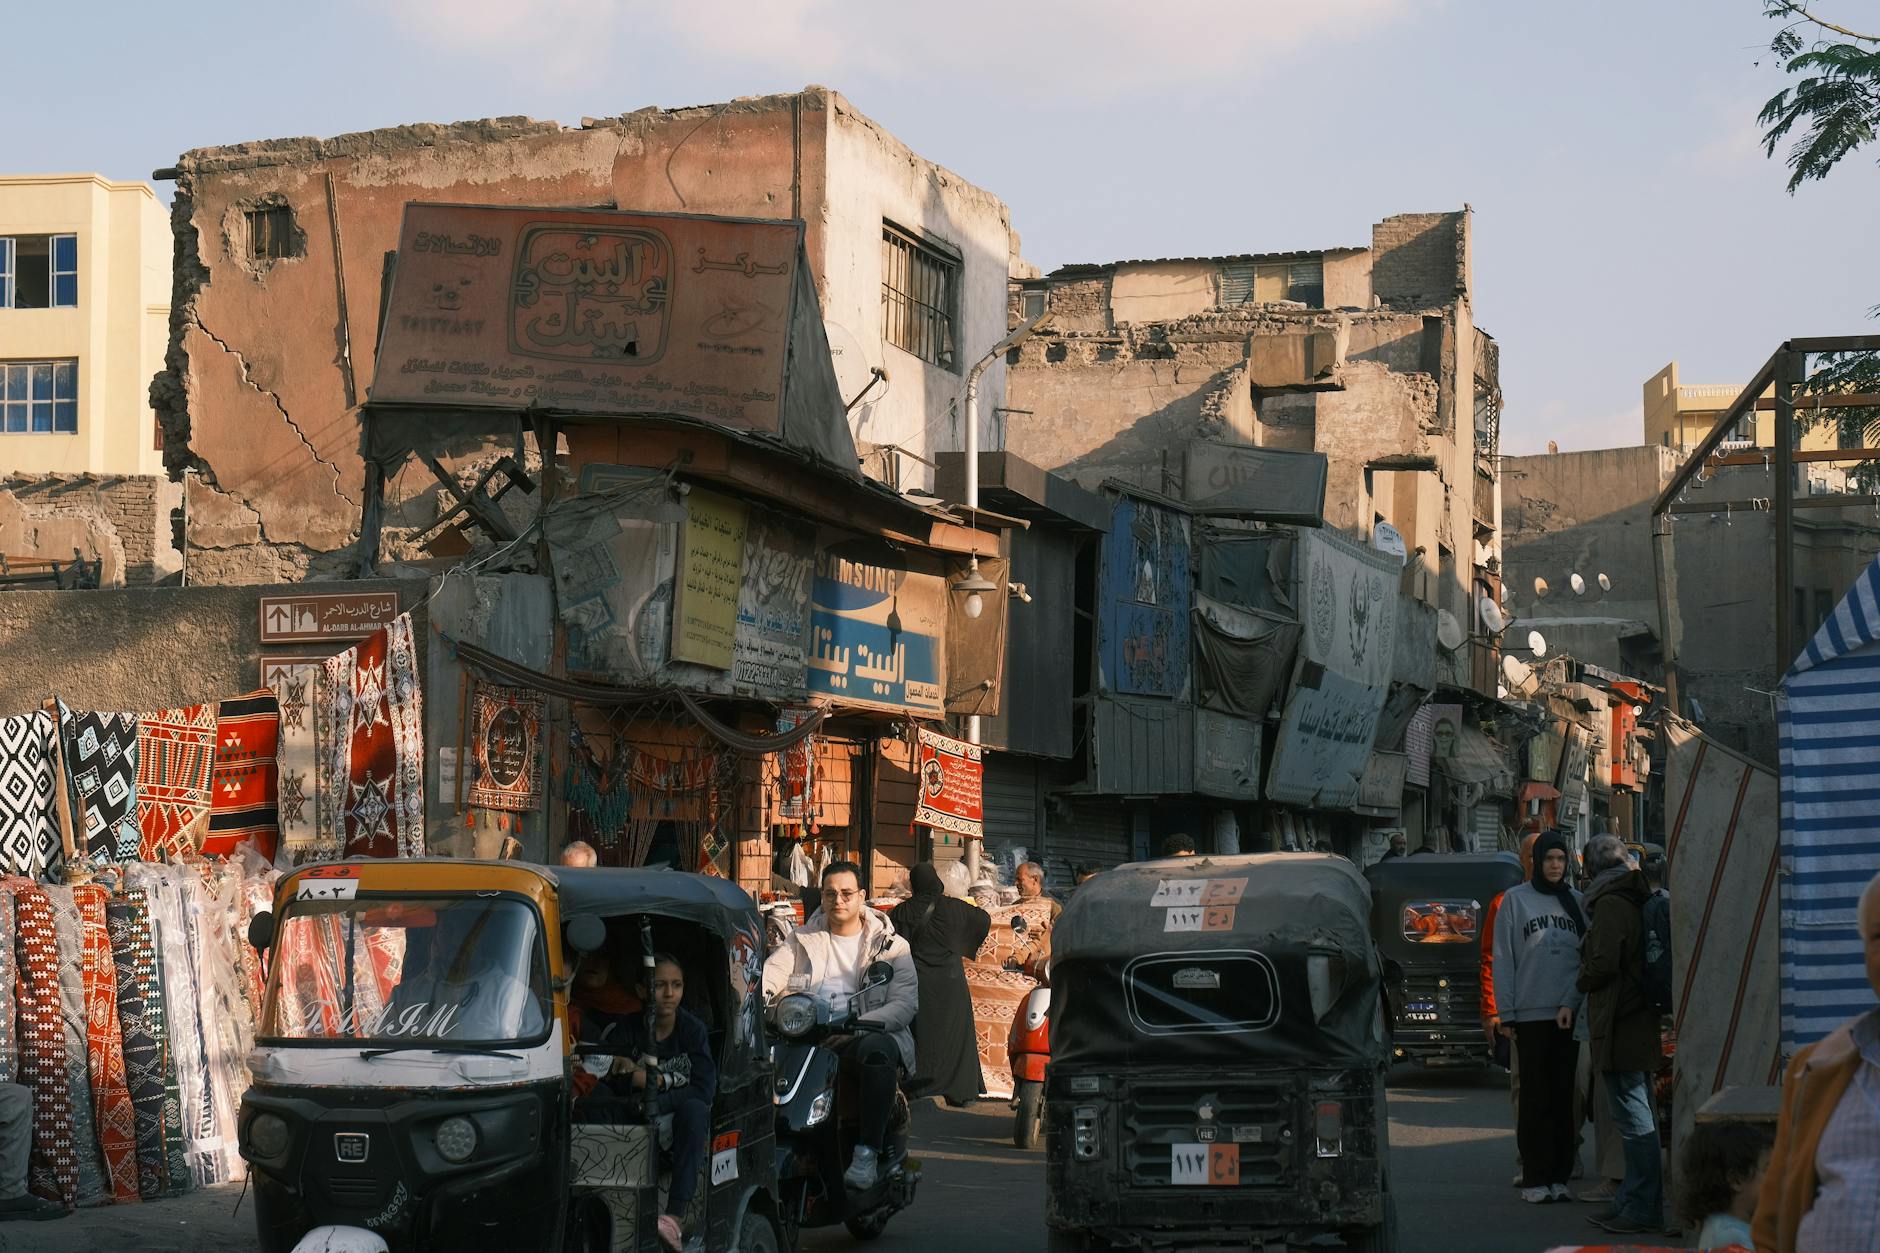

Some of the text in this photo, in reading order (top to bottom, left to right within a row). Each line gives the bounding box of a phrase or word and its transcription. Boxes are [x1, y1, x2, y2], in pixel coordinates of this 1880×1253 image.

[413, 231, 503, 257] للاتصالات
[536, 242, 644, 295] البيت
[691, 247, 788, 279] مركز
[527, 292, 640, 358] بيتك
[816, 552, 896, 594] SAMSUNG
[322, 601, 392, 619] شارع الدرب الاحمر
[322, 623, 349, 633] AL-DARB
[855, 642, 905, 695] البيت
[1523, 914, 1577, 943] NEW YOR
[1200, 1131, 1213, 1139] RE
[340, 1143, 363, 1157] RE
